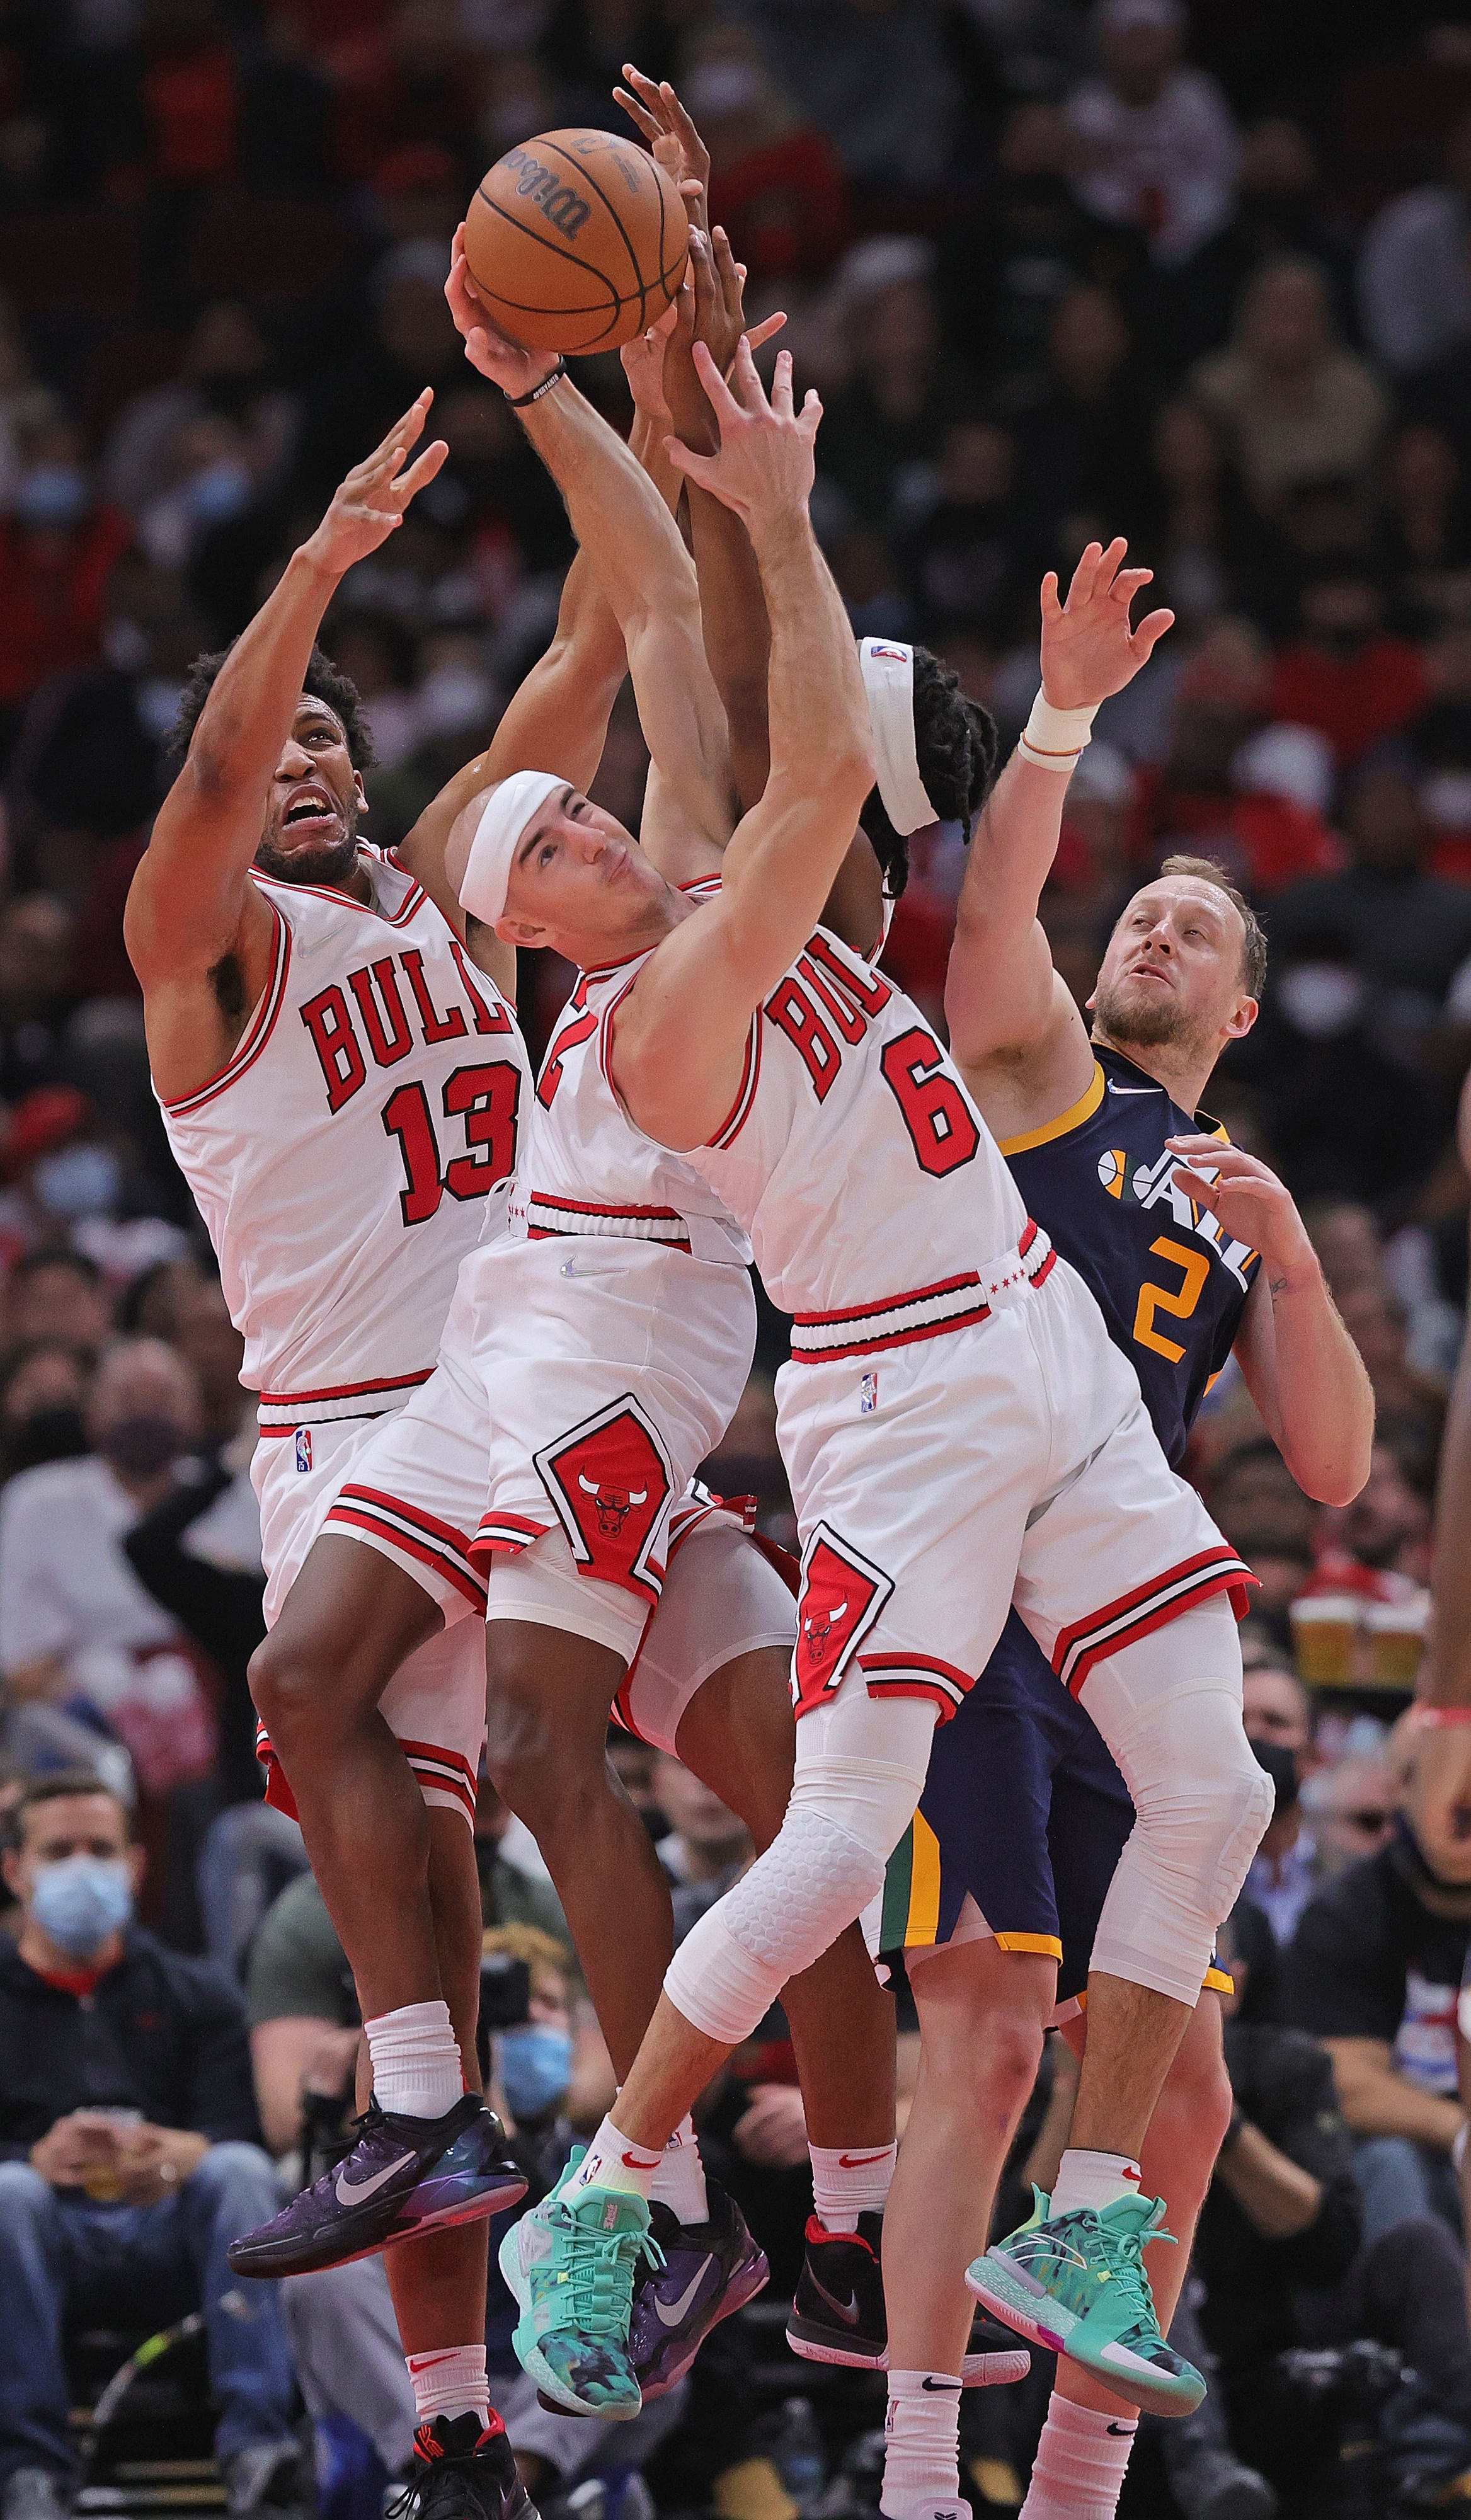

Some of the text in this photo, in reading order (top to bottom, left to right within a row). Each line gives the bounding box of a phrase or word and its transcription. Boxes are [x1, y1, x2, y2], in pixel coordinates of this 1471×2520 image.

[299, 941, 514, 1116] BULL
[762, 932, 893, 1106] BUL
[381, 1059, 522, 1228] 13
[879, 1026, 981, 1179] 6
[1133, 1236, 1210, 1364] 2
[298, 1460, 305, 1471] 75
